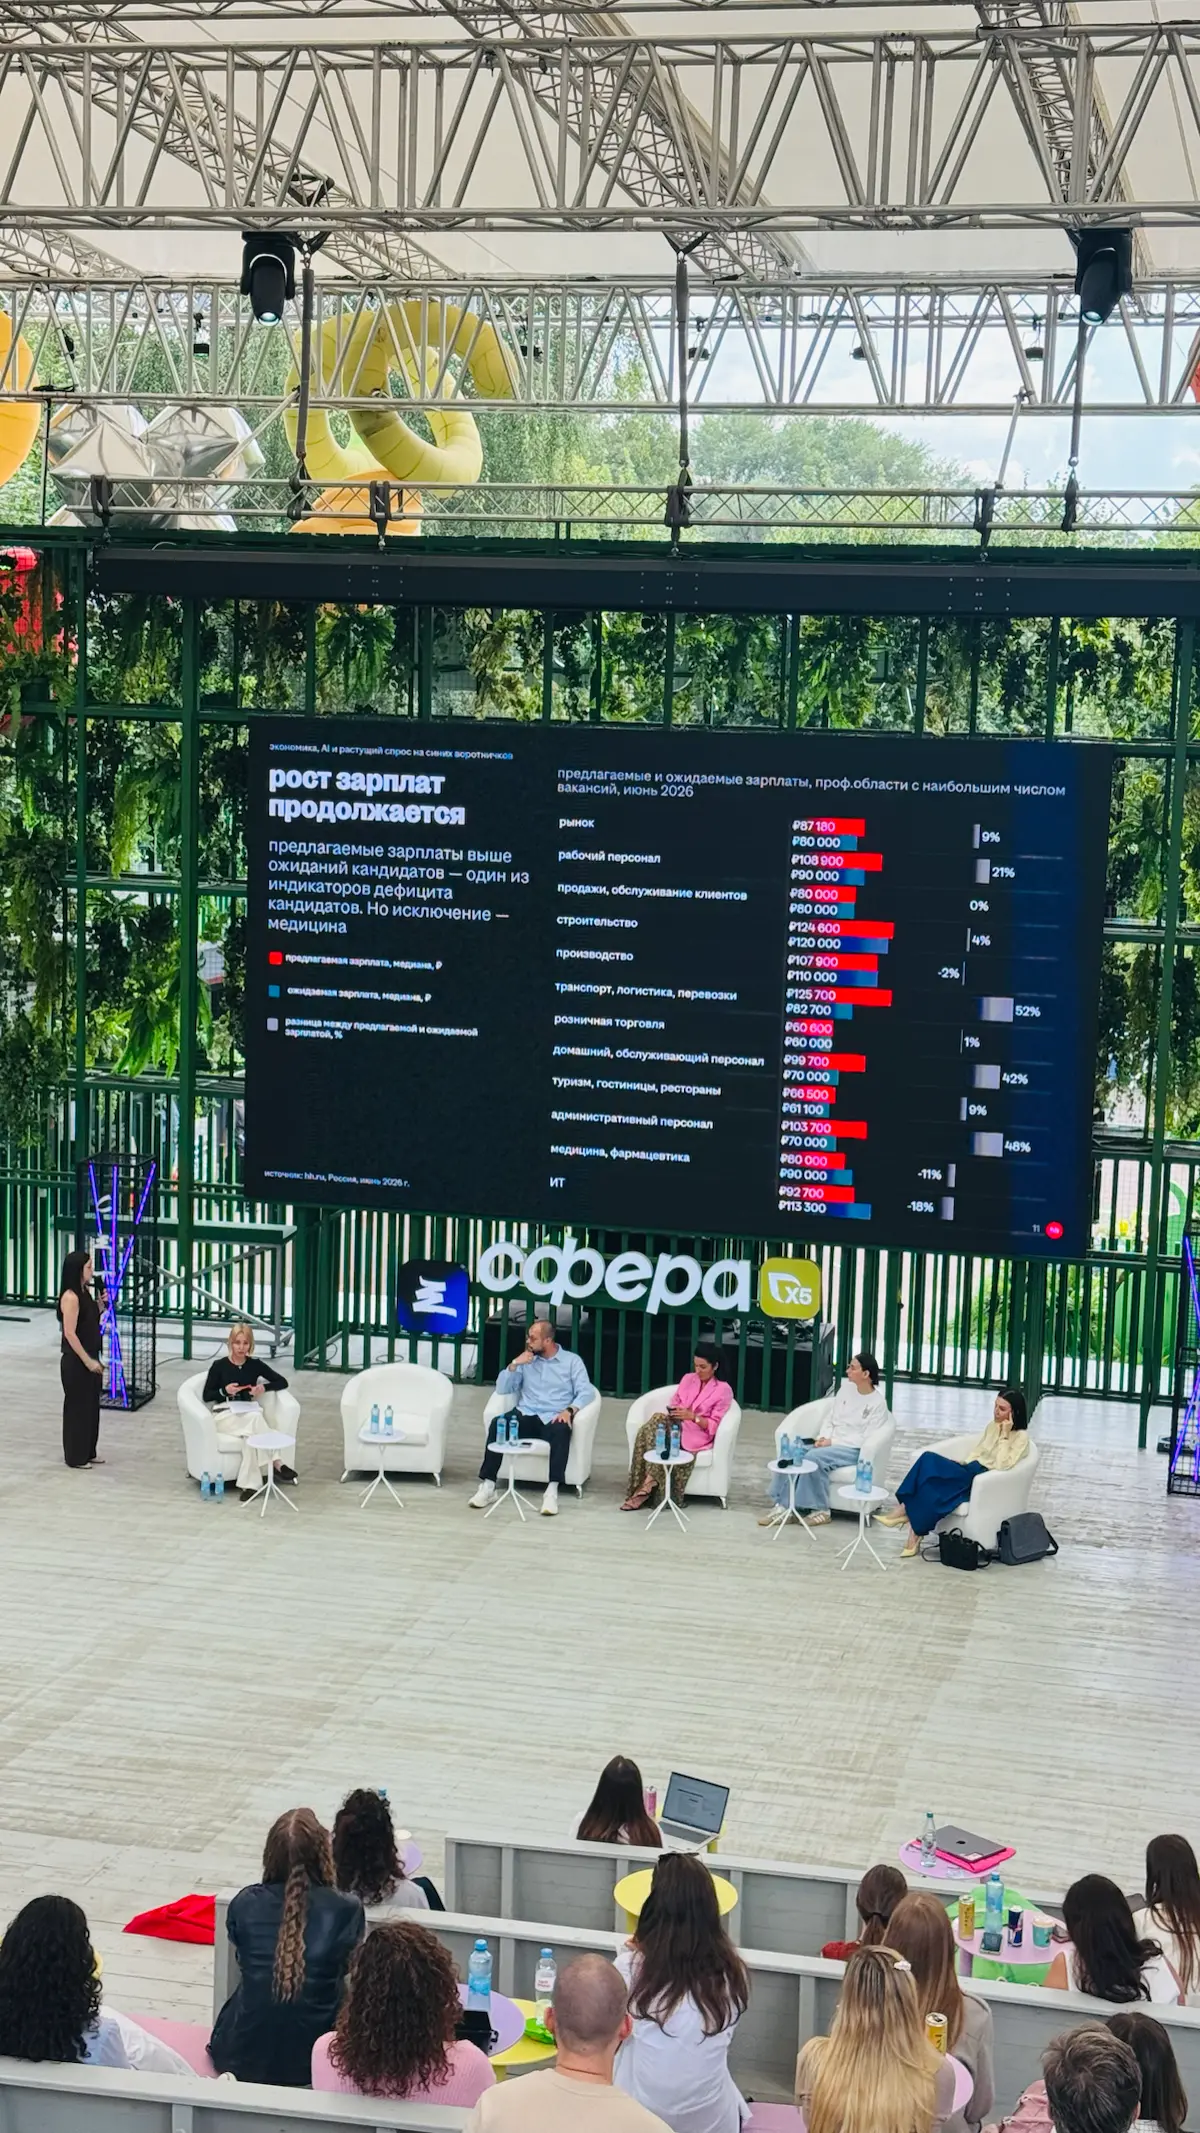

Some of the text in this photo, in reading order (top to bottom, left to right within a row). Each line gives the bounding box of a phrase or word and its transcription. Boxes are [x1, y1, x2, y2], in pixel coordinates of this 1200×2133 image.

[269, 743, 513, 760] экономика, AI и растущий спрос на синих воротничков
[269, 768, 446, 797] рост зарплат
[557, 769, 1066, 796] предлагаемые и ожидаемые зарплаты, проф.области с наибольшим числом
[557, 782, 694, 798] вакансий, июнь 2026
[268, 797, 466, 826] продолжается
[559, 817, 595, 829] рынок
[815, 821, 836, 832] 180
[817, 836, 841, 848] 000
[981, 831, 1001, 843] 9%
[268, 839, 512, 863] предлагаемые зарплаты выше
[558, 849, 661, 864] рабочий персонал
[820, 855, 844, 867] 900
[268, 857, 348, 877] ожиданий
[352, 864, 445, 881] кандидатов
[466, 869, 506, 885] один
[510, 871, 529, 885] из
[815, 870, 839, 882] 000
[991, 866, 1015, 878] 21%
[268, 879, 453, 901] индикаторов дефицита
[557, 883, 748, 901] продажи, обслуживание клиентов
[815, 888, 838, 901] 000
[268, 899, 363, 917] кандидатов.
[367, 902, 388, 917] Но
[392, 905, 491, 921] исключение
[814, 904, 838, 916] 000
[969, 900, 989, 911] 0%
[268, 918, 347, 934] медицина
[557, 915, 638, 928] строительство
[817, 922, 840, 934] 600
[817, 937, 841, 949] 000
[971, 935, 991, 946] 4%
[556, 949, 634, 962] производство
[815, 956, 839, 967] 900
[285, 954, 348, 966] предлагаемая
[349, 957, 392, 969] зарплата,
[393, 959, 434, 971] медиана,
[813, 971, 837, 983] 000
[937, 967, 960, 979] -2%
[287, 987, 337, 998] ожидаемая
[338, 989, 381, 1001] зарплата,
[382, 991, 423, 1003] медиана,
[555, 982, 737, 1001] транспорт, логистика, перевозки
[814, 989, 836, 1001] 700
[809, 1004, 831, 1016] 700
[1015, 1006, 1041, 1018] 52%
[285, 1017, 322, 1028] разница
[323, 1020, 352, 1031] между
[354, 1021, 417, 1033] предлагаемой
[426, 1025, 478, 1036] ожидаемой
[554, 1014, 665, 1030] розничная торговля
[809, 1022, 832, 1034] 600
[285, 1028, 343, 1039] зарплатой, %
[808, 1037, 833, 1049] 000
[964, 1037, 980, 1048] 1%
[552, 1045, 765, 1067] домашний, обслуживающий персонал
[807, 1055, 829, 1067] 700
[806, 1070, 830, 1082] 000
[1002, 1073, 1029, 1085] 42%
[552, 1076, 721, 1096] туризм, гостиницы, рестораны
[806, 1088, 829, 1100] 500
[803, 1103, 824, 1115] 100
[969, 1104, 987, 1116] 9%
[551, 1110, 713, 1129] административный персонал
[809, 1121, 832, 1133] 700
[803, 1136, 828, 1148] 000
[1004, 1141, 1031, 1153] 48%
[550, 1144, 690, 1163] медицина, фармацевтика
[804, 1154, 828, 1167] 000
[264, 1170, 303, 1180] источник:
[328, 1173, 359, 1184] Россия,
[359, 1177, 381, 1185] июнь
[382, 1177, 403, 1187] 2026
[803, 1169, 828, 1181] 000
[917, 1169, 942, 1181] -11%
[550, 1177, 565, 1188] ИТ
[802, 1187, 824, 1198] 700
[803, 1202, 827, 1214] 300
[907, 1201, 934, 1213] -18%
[1032, 1224, 1040, 1233] 11
[477, 1237, 751, 1315] сфера
[785, 1283, 812, 1306] X5
